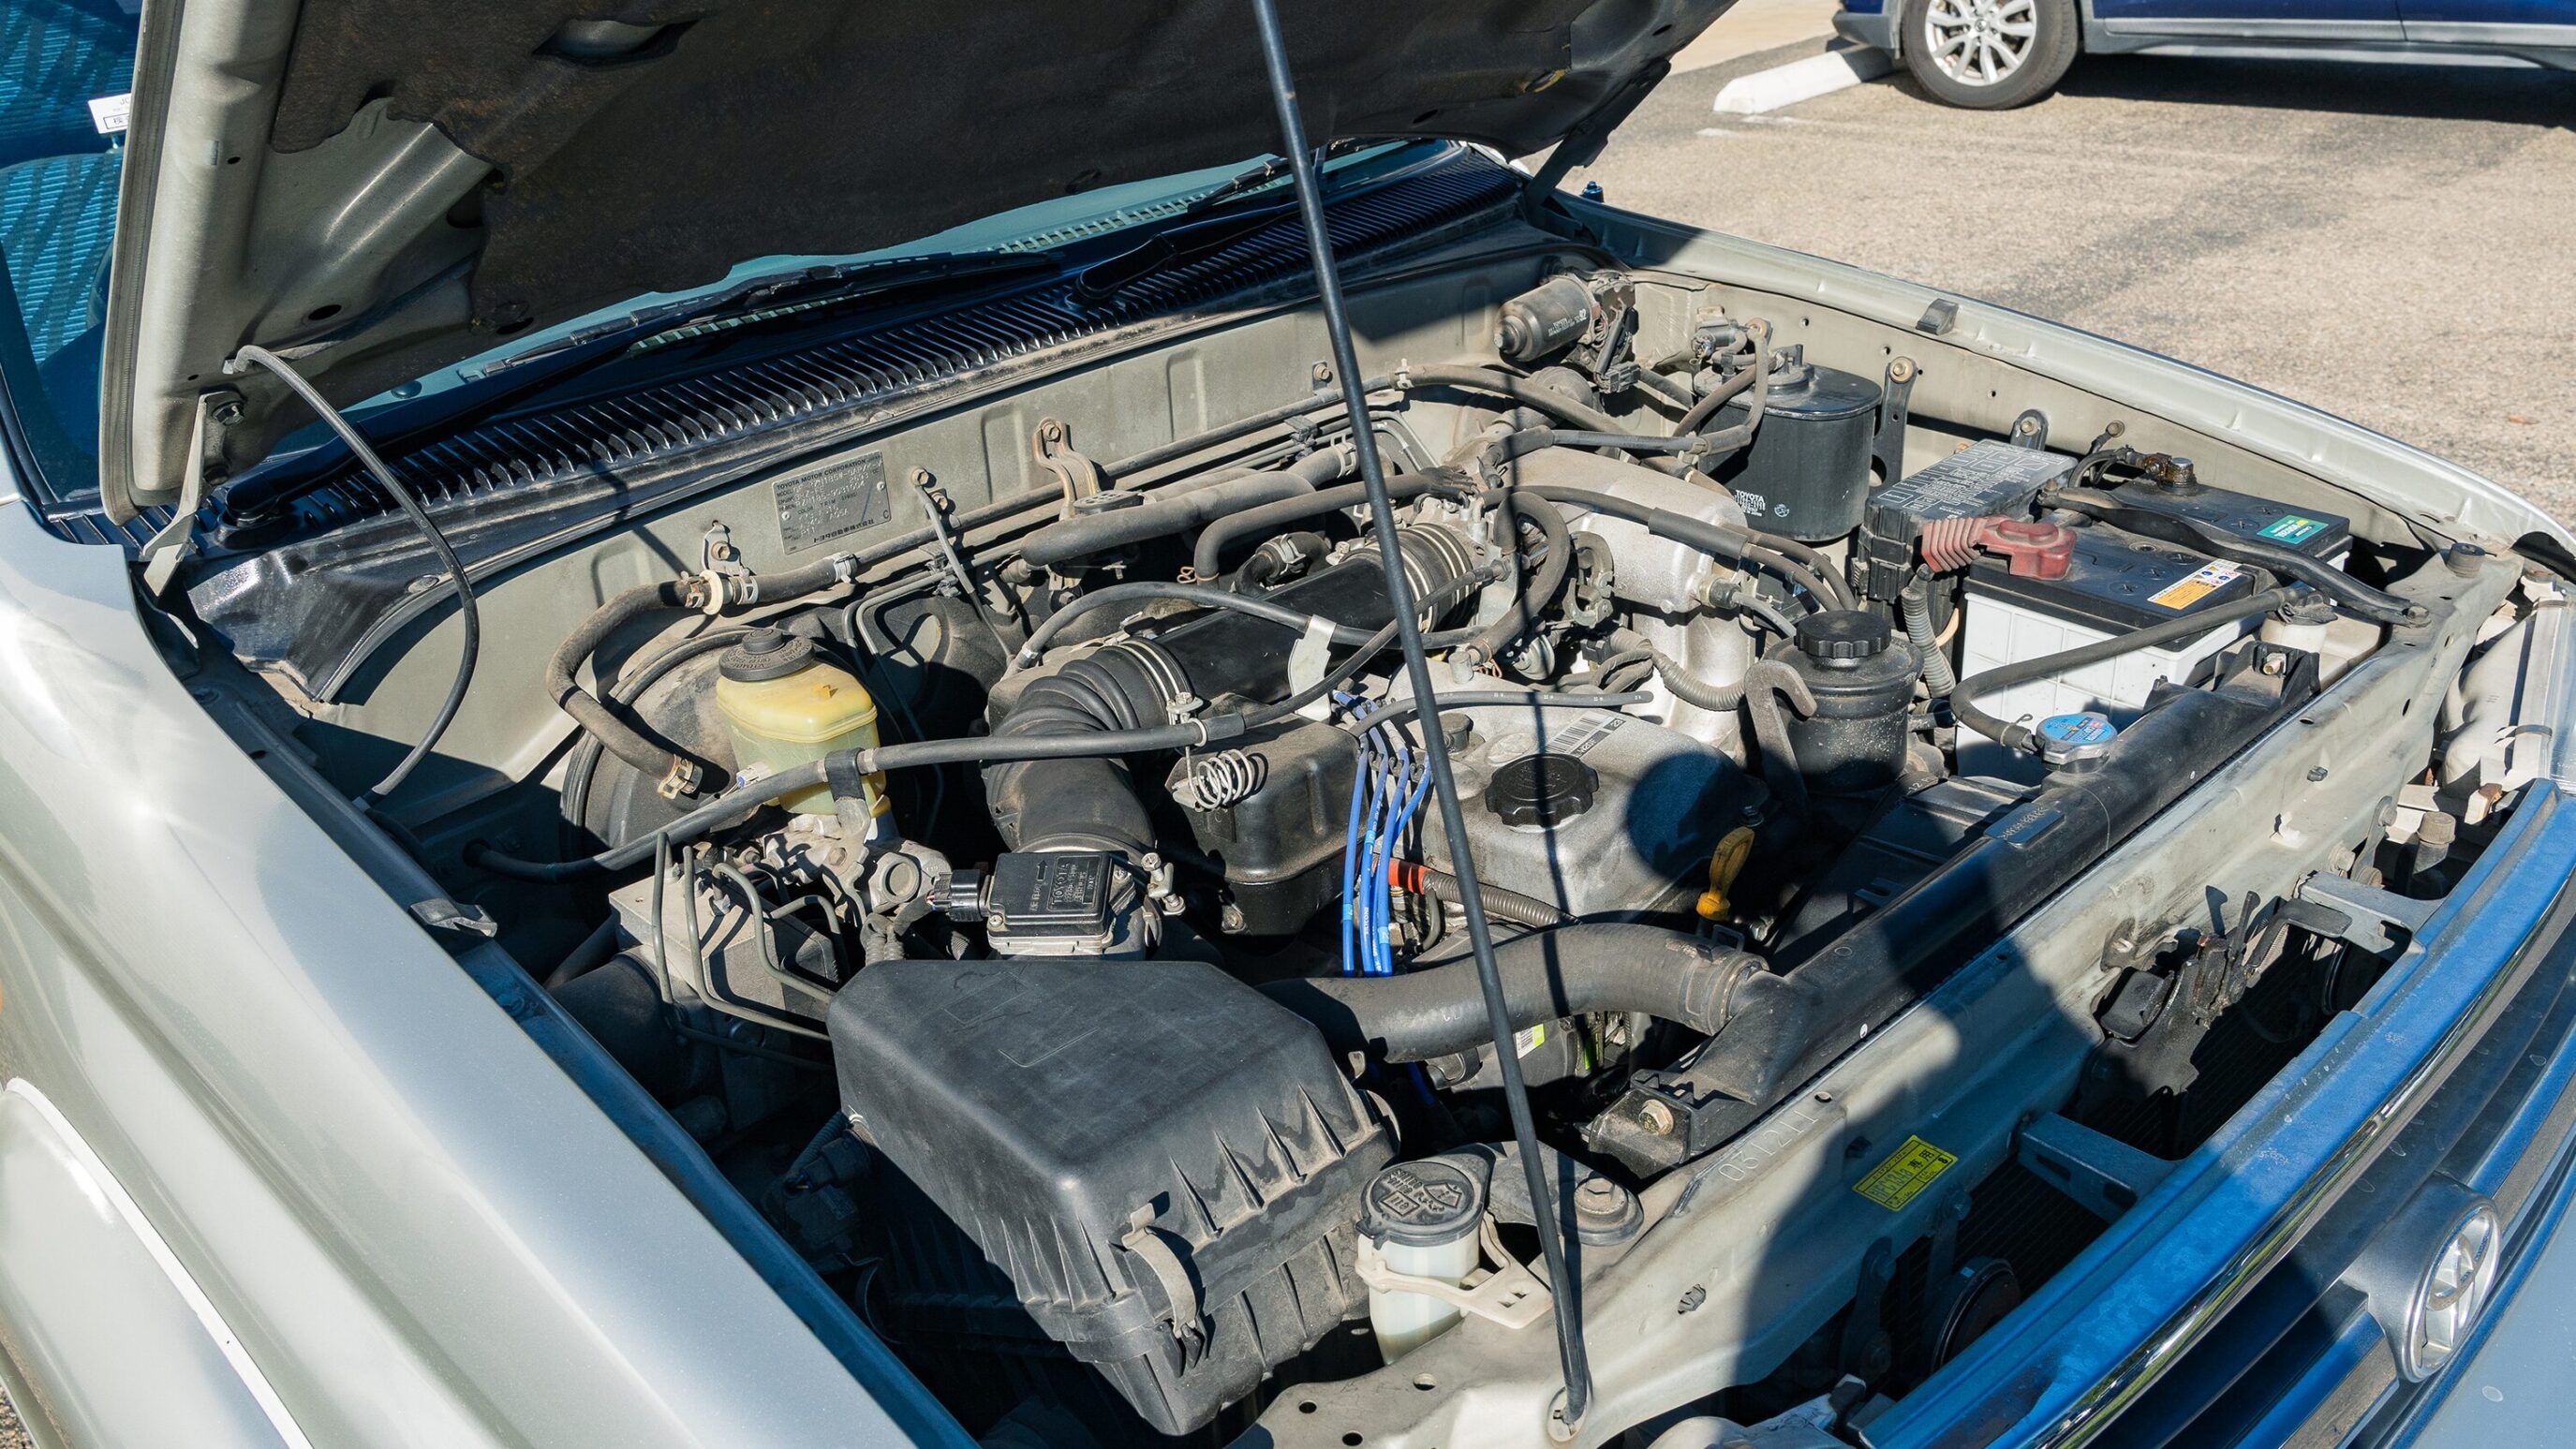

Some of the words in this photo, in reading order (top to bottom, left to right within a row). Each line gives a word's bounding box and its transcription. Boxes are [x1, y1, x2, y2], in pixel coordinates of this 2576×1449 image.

[777, 480, 799, 490] TOYOTA
[801, 472, 822, 482] MOTOR
[824, 459, 866, 476] CORPORATION
[1052, 864, 1069, 905] TOYOTA
[1718, 1109, 1819, 1181] 031211
